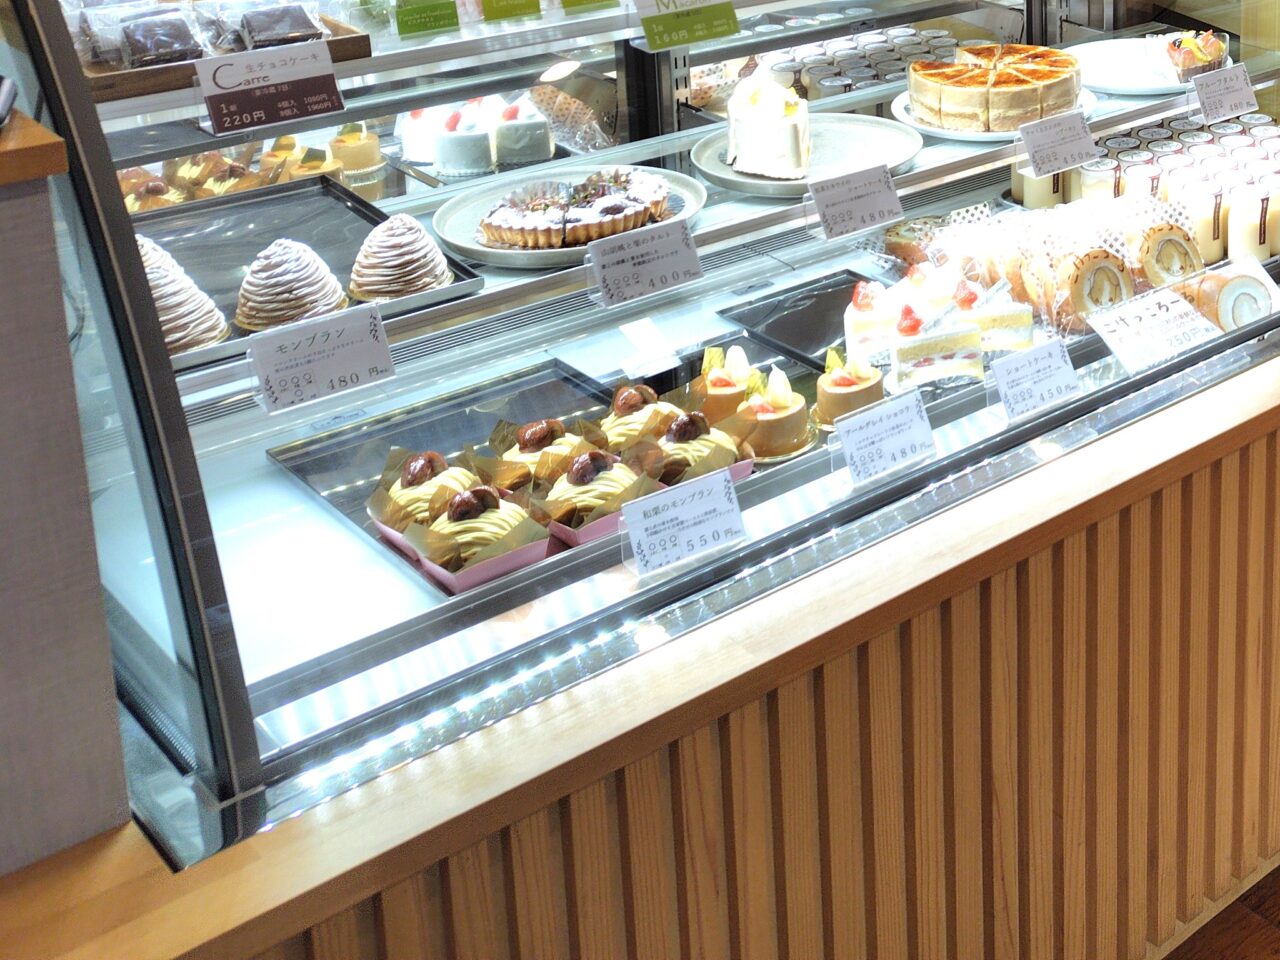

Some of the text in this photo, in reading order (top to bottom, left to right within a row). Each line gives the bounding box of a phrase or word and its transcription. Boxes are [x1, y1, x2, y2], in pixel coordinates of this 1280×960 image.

[244, 52, 321, 75] 生チョコケーキ
[223, 109, 266, 128] 220円
[276, 327, 346, 355] モンブラン
[642, 487, 714, 520] 和栗のモンブラン
